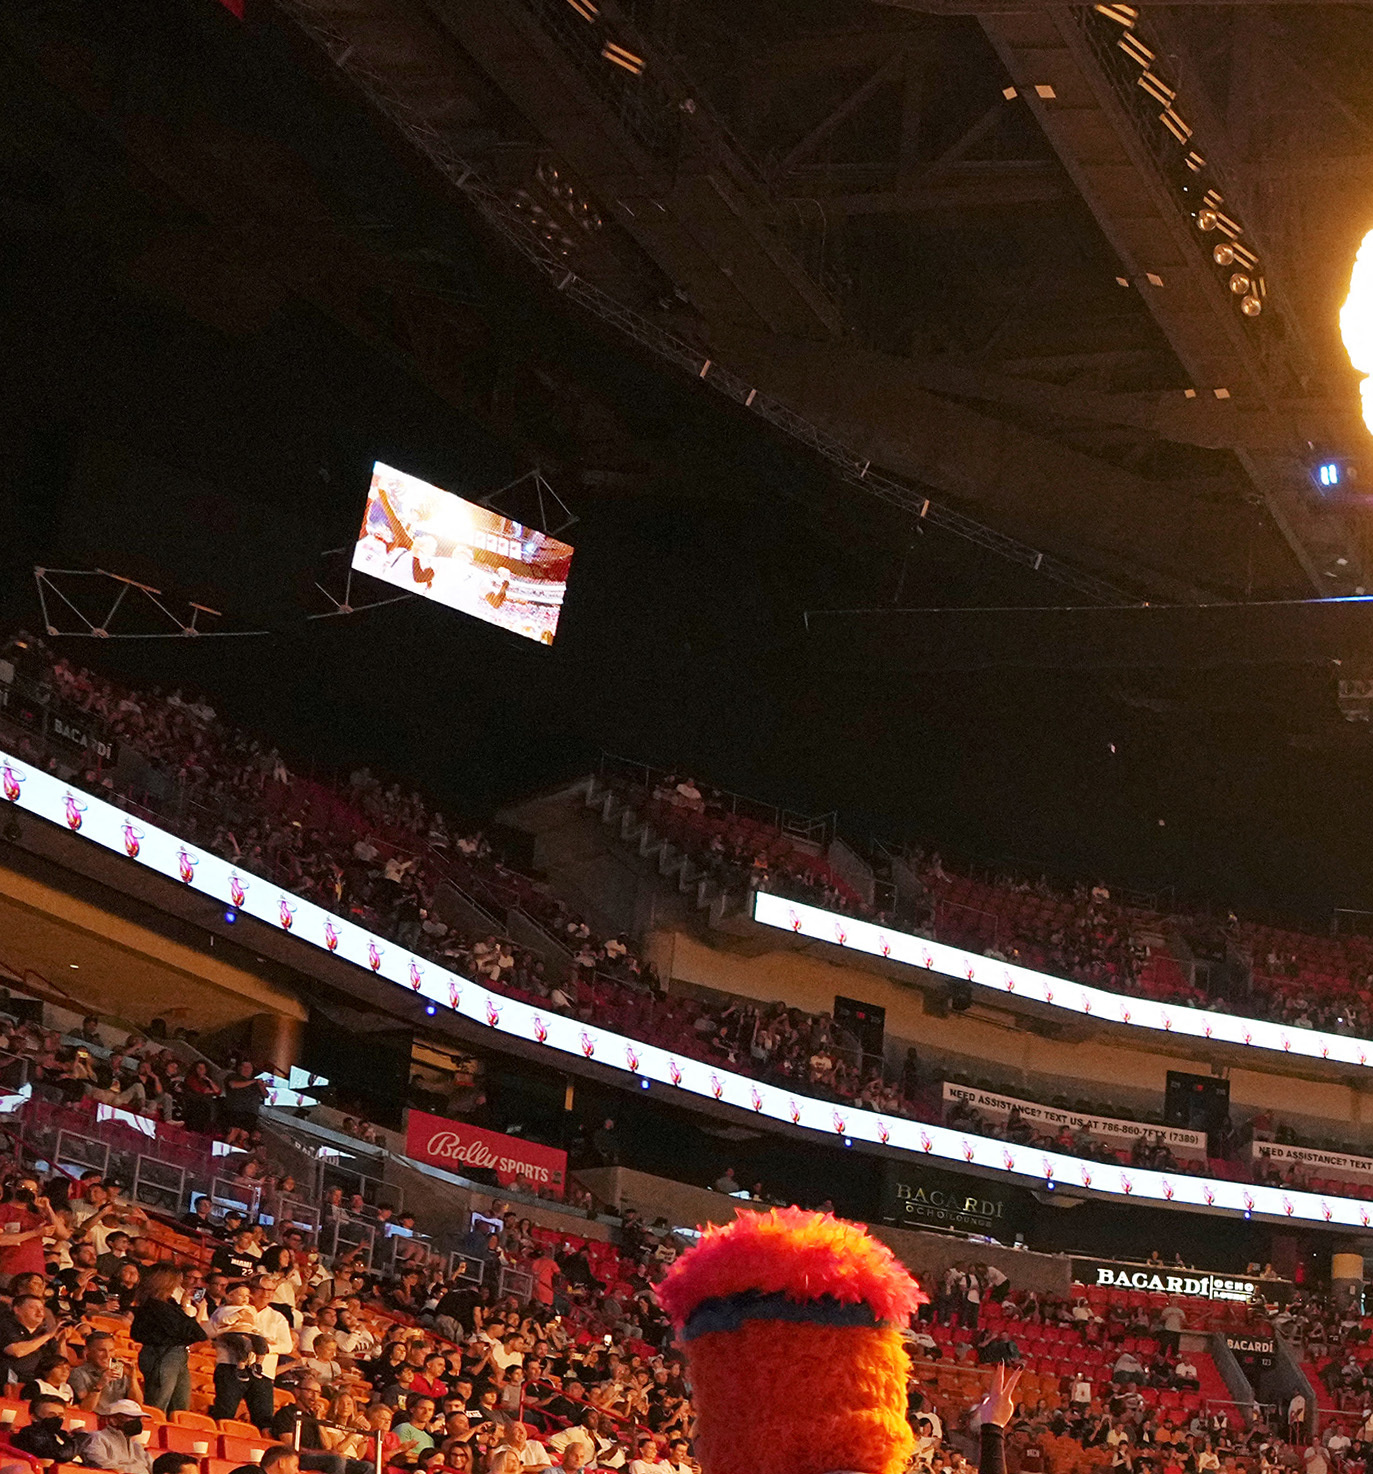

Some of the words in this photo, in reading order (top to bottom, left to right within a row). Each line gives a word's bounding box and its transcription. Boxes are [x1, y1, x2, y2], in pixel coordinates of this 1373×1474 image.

[950, 1088, 976, 1102] NEED
[978, 1096, 1042, 1118] ASSISTANCE?
[1044, 1111, 1069, 1124] TEXT
[1070, 1116, 1084, 1127] US
[1087, 1120, 1099, 1130] AT
[1169, 1132, 1199, 1145] (7389)
[427, 1131, 498, 1169] Bally
[499, 1157, 549, 1182] SPORTS
[1259, 1146, 1284, 1158] NEED
[1286, 1150, 1347, 1167] ASSISTANCE?
[1350, 1160, 1373, 1171] TEXT
[906, 1204, 945, 1219] OCHO
[1213, 1279, 1254, 1292] OCHO
